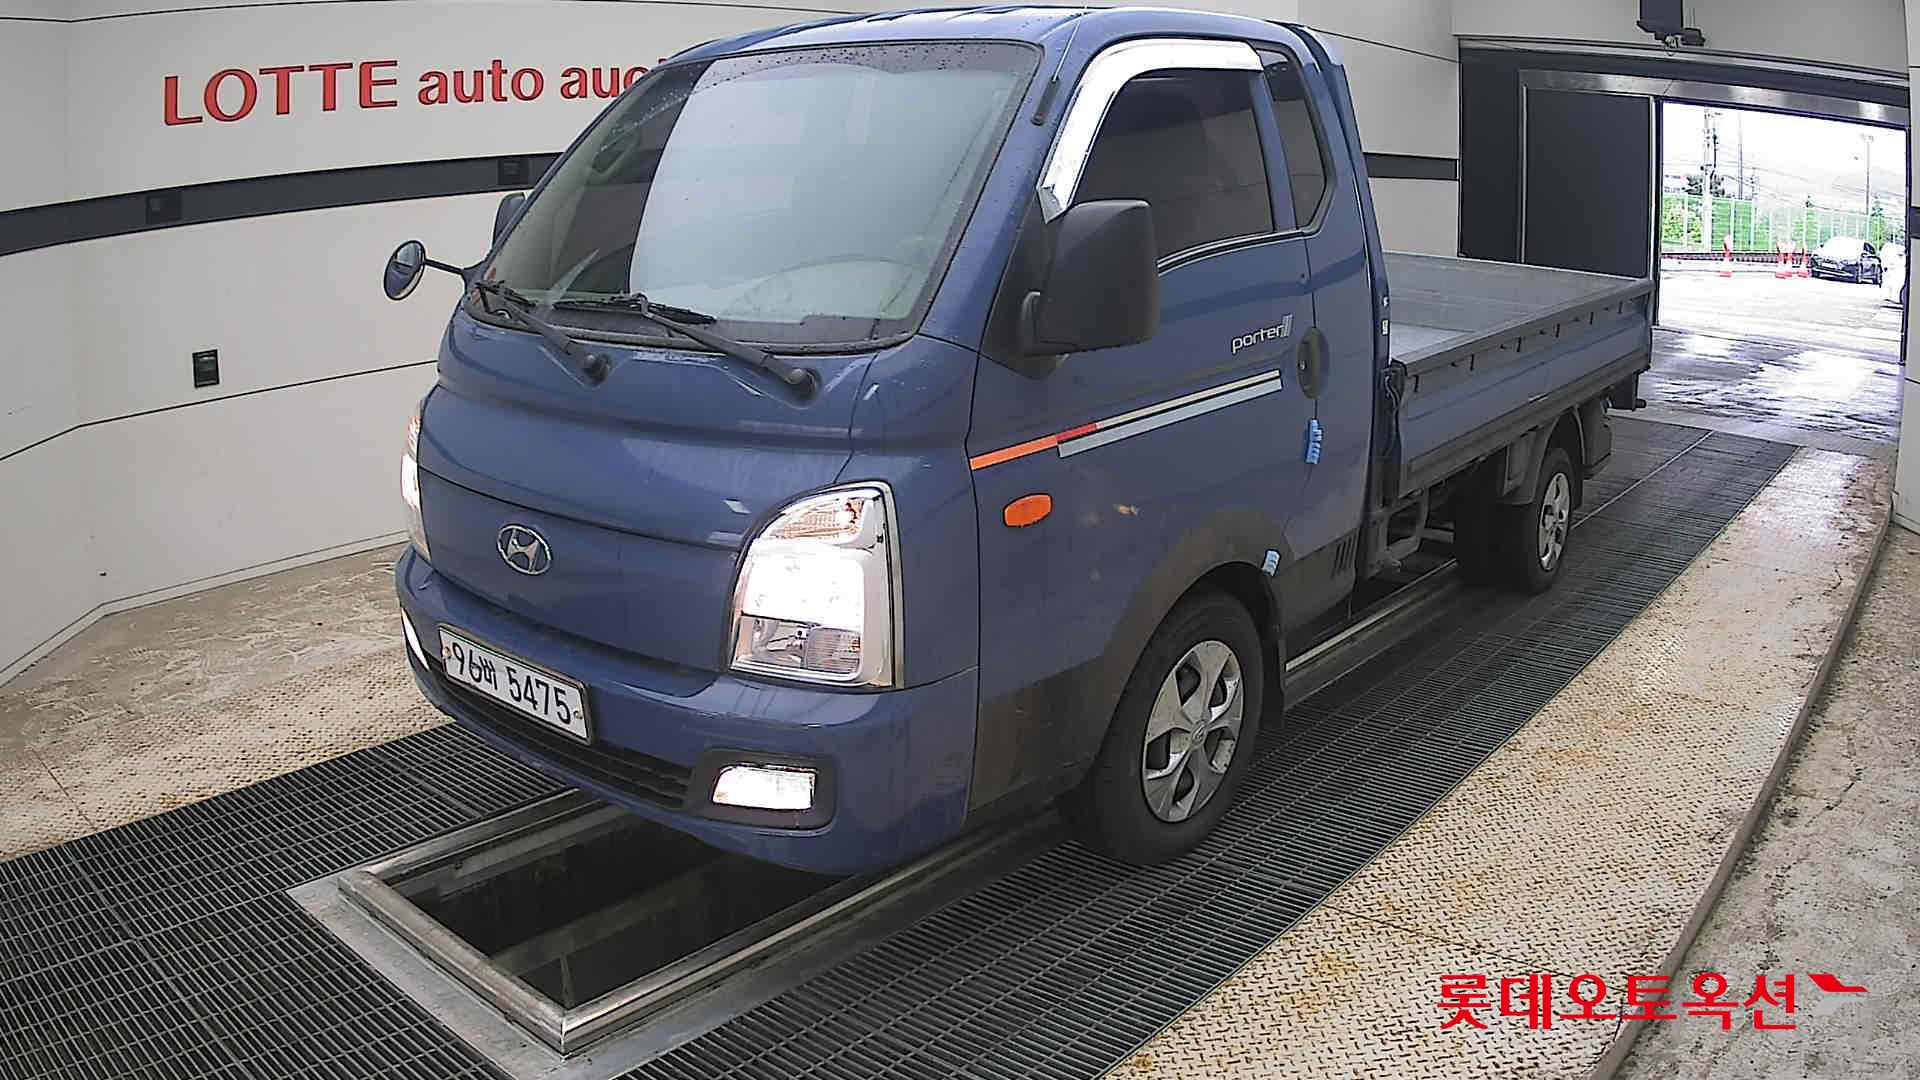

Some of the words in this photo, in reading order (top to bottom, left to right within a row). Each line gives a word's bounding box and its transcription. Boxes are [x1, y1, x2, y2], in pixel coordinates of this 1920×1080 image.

[163, 59, 398, 126] LOTTE
[418, 58, 544, 106] auto
[560, 58, 668, 99] auc
[506, 666, 571, 725] 5475
